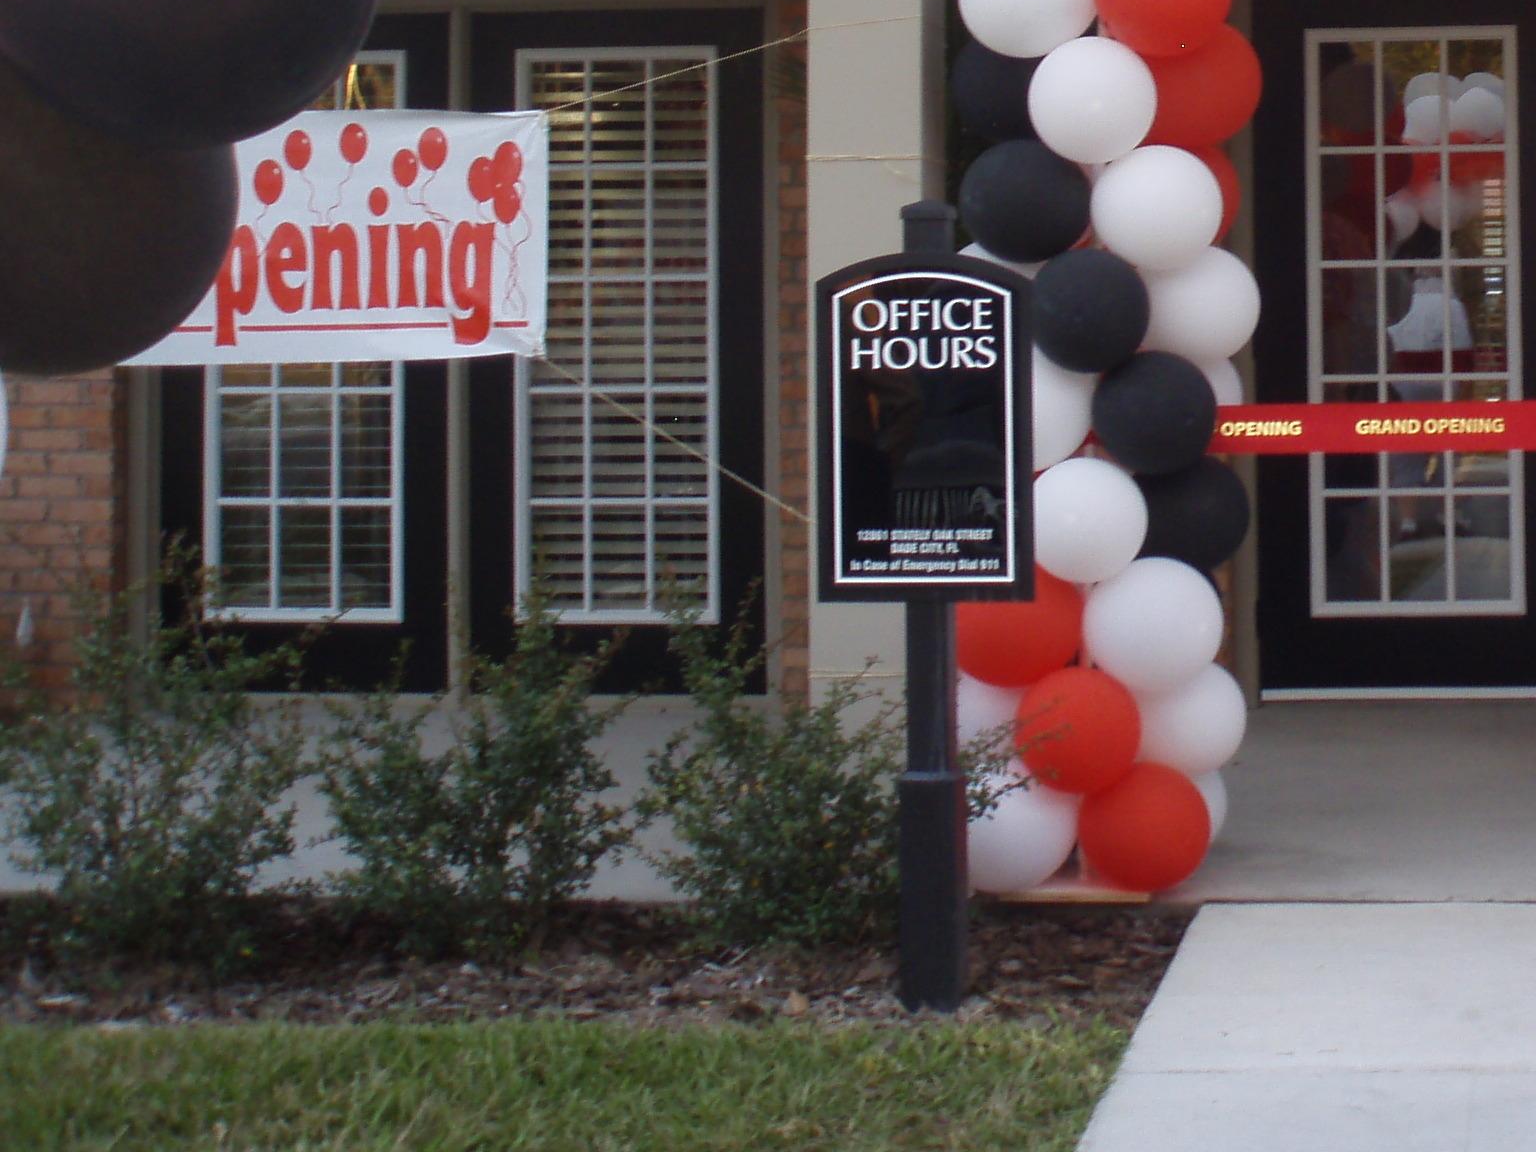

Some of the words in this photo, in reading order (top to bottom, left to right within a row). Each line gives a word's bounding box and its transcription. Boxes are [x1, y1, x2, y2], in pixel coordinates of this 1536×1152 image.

[214, 188, 496, 347] pening
[851, 298, 993, 332] OFFICE
[850, 335, 997, 370] HOURS
[1219, 420, 1302, 436] OPENING
[1355, 418, 1422, 435] GRAND
[1423, 417, 1505, 434] OPENING
[954, 528, 994, 540] STREET
[850, 559, 862, 571] In
[863, 559, 889, 571] Case
[889, 559, 901, 571] of
[902, 559, 956, 573] Emergency
[957, 559, 979, 571] Dial
[979, 558, 1001, 570] 911
